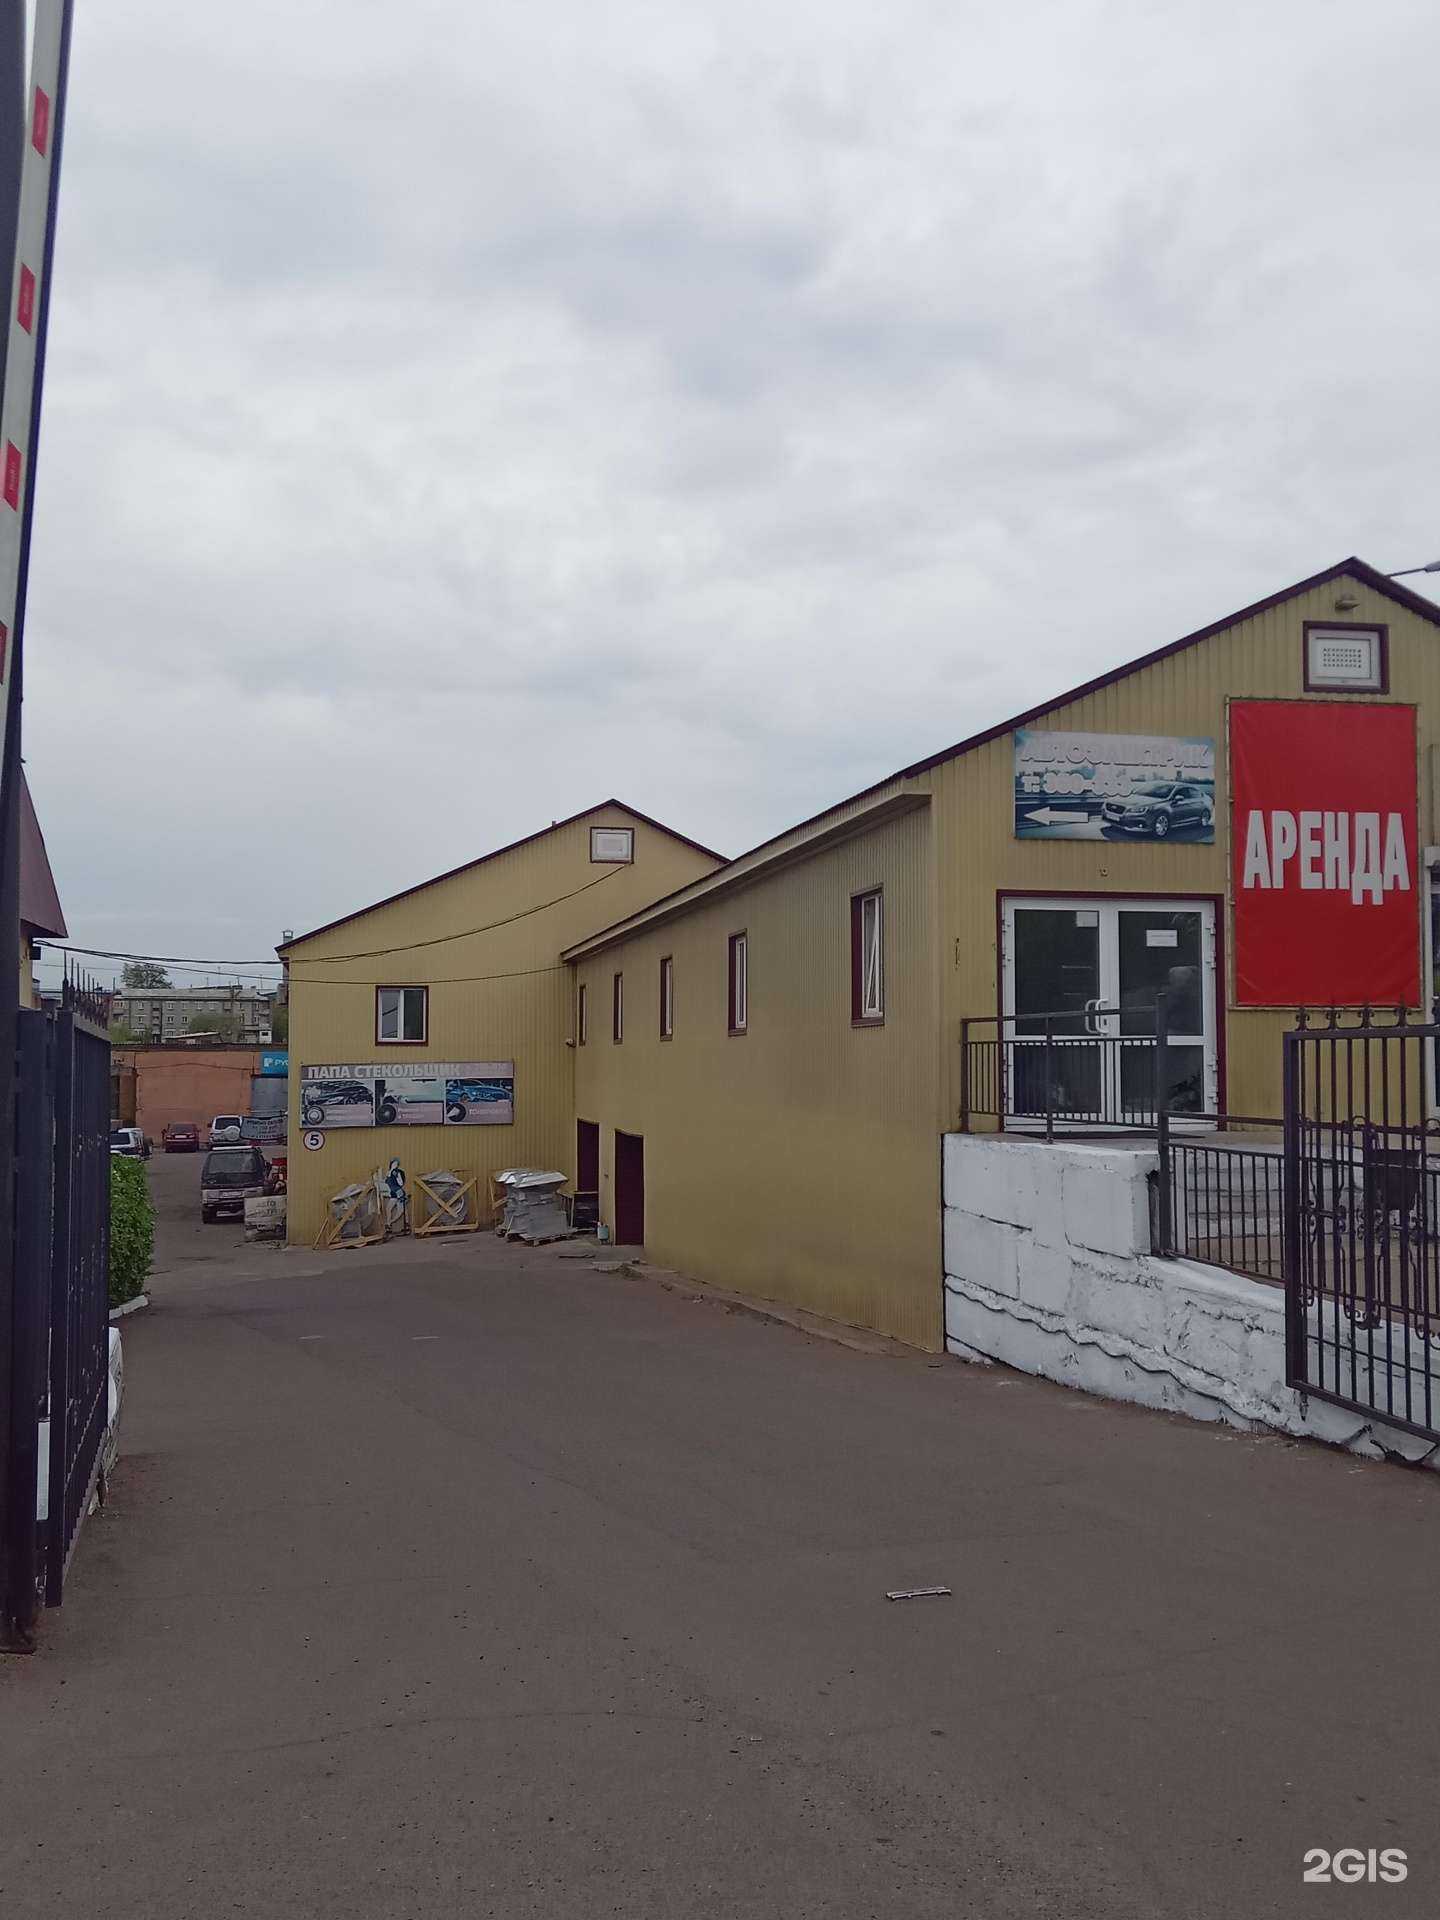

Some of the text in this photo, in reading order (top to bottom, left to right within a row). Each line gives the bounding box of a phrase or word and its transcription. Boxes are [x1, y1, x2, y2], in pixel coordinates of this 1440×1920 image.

[1243, 810, 1411, 905] АРЕНДА
[308, 1066, 351, 1079] ПАПА
[354, 1064, 463, 1078] СТЕКОЛЬЩИК
[309, 1134, 320, 1146] 5
